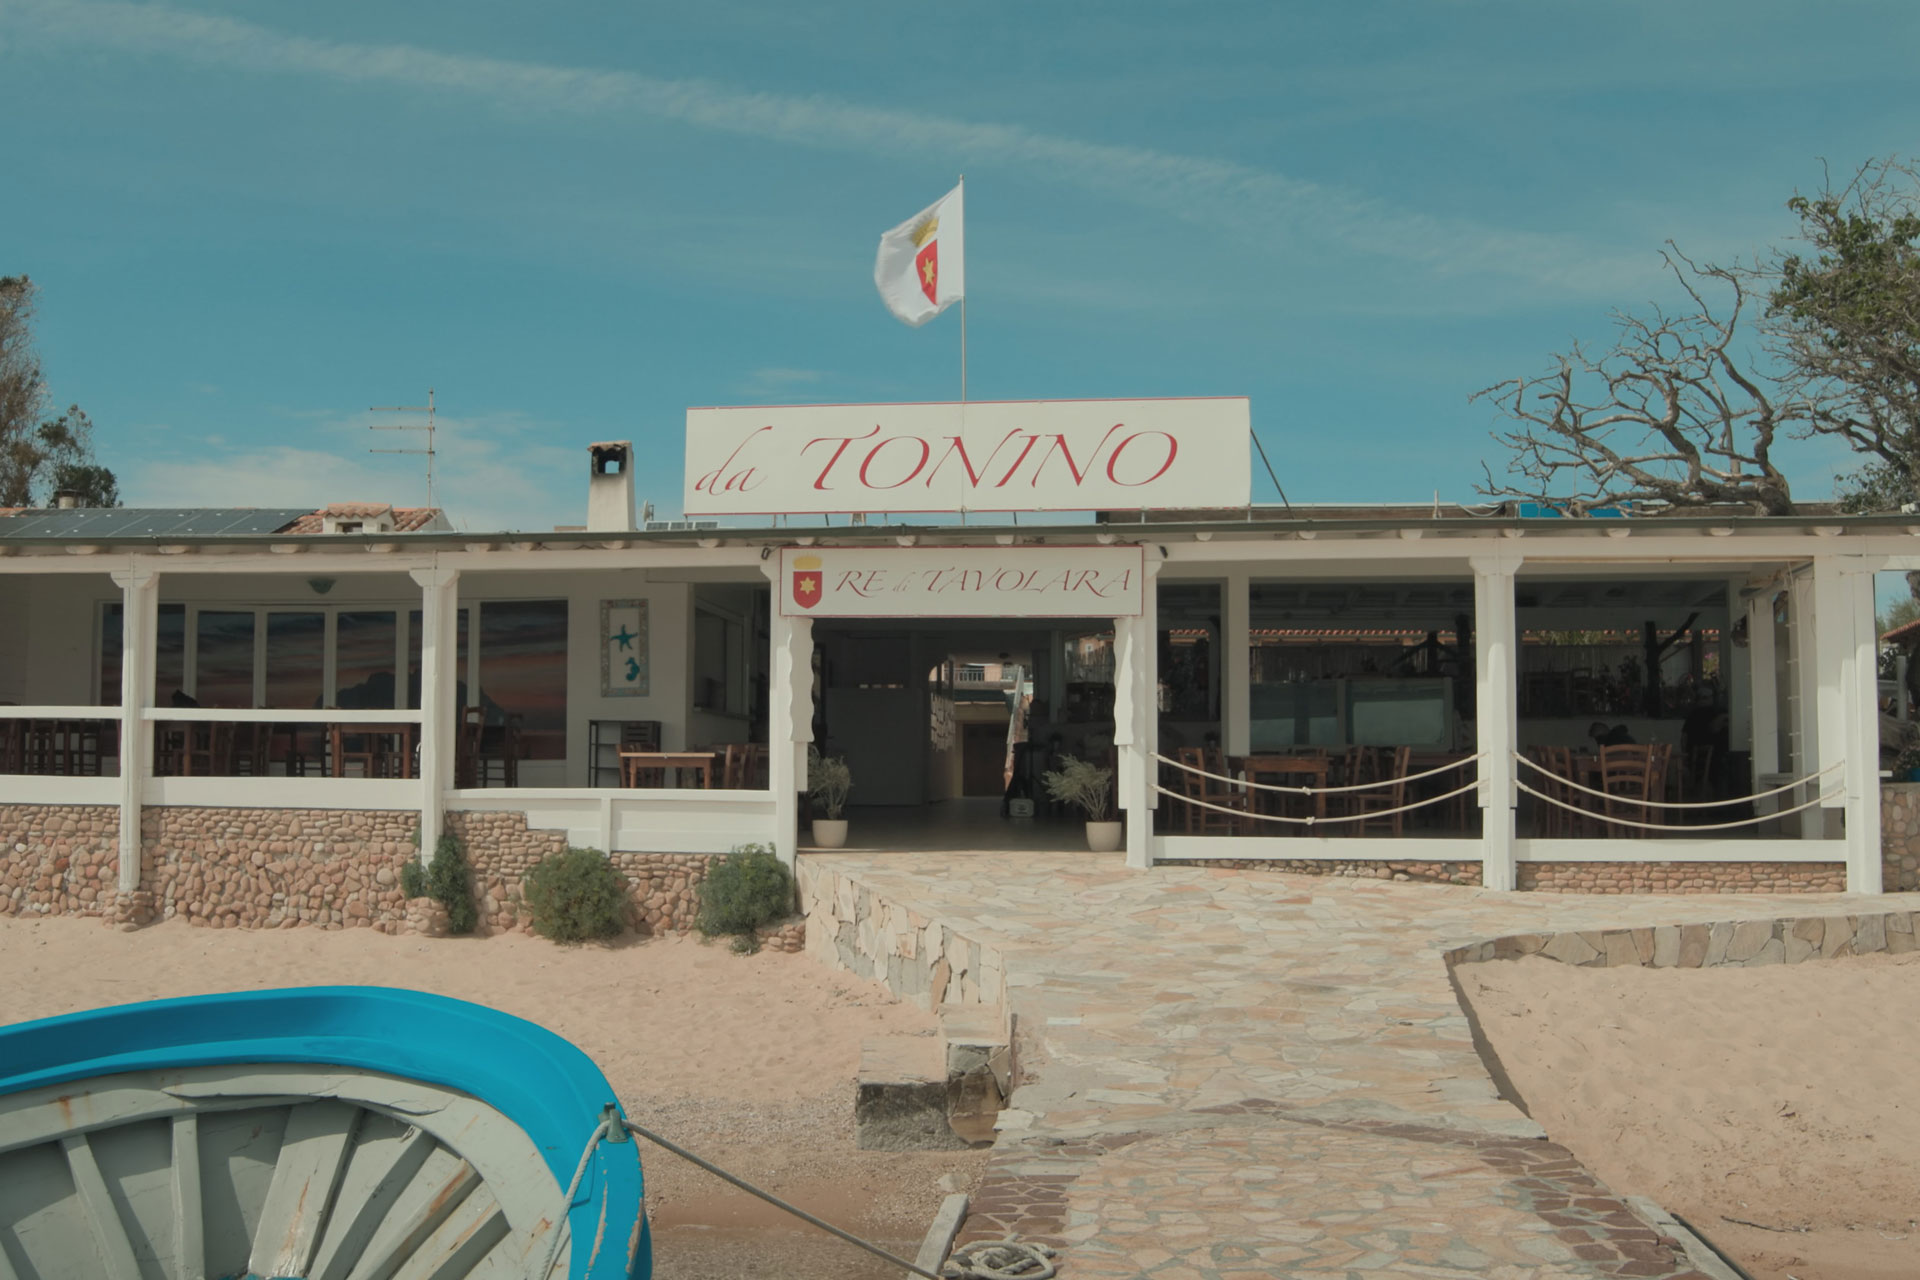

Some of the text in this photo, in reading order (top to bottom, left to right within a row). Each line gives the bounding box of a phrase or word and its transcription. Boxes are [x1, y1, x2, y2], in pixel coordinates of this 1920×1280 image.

[694, 424, 1178, 495] da TONINO
[835, 567, 1131, 598] RE di TAVOLARA
